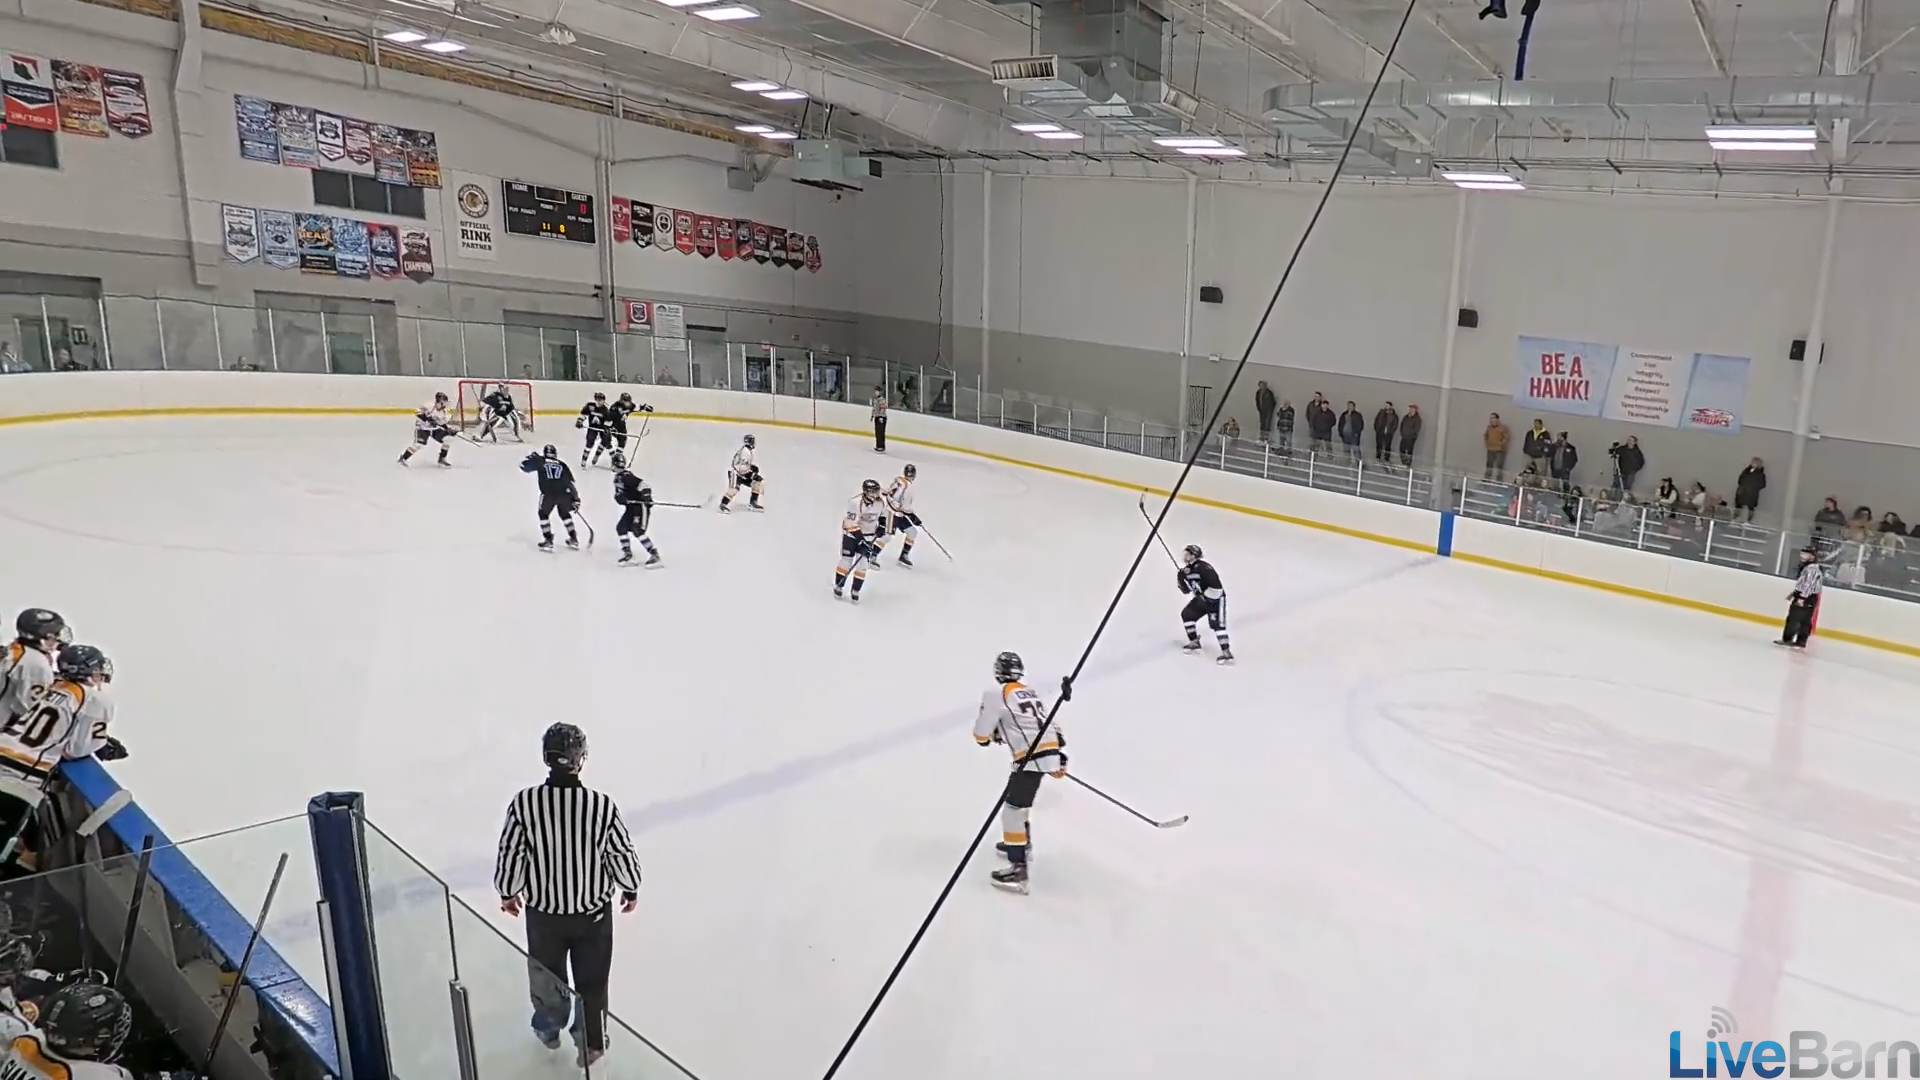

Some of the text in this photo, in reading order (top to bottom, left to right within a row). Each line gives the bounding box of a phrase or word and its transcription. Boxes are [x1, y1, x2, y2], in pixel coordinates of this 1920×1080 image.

[512, 184, 588, 202] HOME GUEST
[460, 221, 491, 231] OFFICIAL
[461, 229, 492, 242] RINK
[462, 242, 492, 251] PARTNER
[1541, 353, 1583, 378] BE A
[1529, 377, 1590, 401] HAWK!
[1634, 386, 1661, 395] Respect
[1621, 401, 1669, 413] Sportsmanship
[1627, 411, 1660, 420] Teamwork
[544, 463, 563, 479] 17
